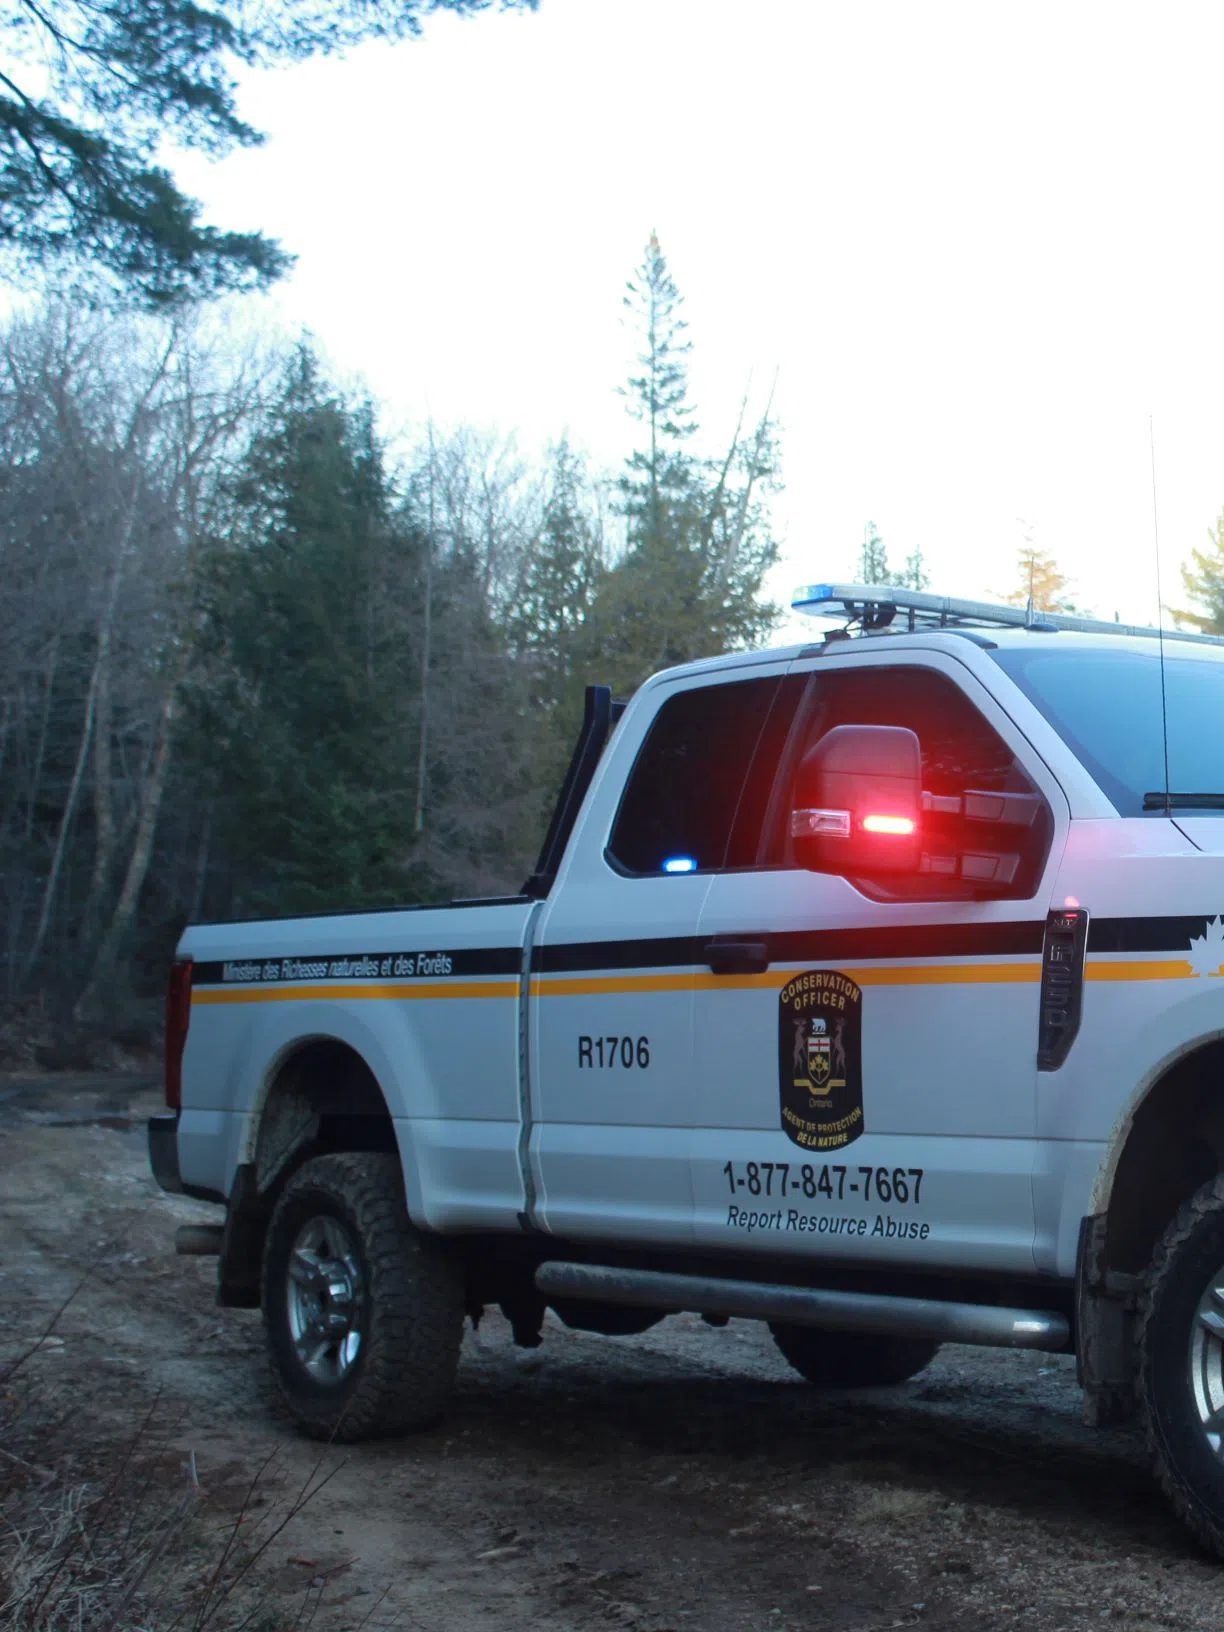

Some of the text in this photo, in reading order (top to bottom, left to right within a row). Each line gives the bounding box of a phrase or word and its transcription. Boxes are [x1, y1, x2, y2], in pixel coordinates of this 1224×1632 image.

[262, 961, 280, 980] des
[281, 959, 329, 979] Richesses
[329, 956, 379, 977] naturelles
[380, 957, 392, 976] et
[394, 955, 415, 976] des
[416, 953, 453, 975] Forêts
[780, 973, 860, 1004] CONSERVATION
[794, 991, 846, 1011] OFFICER
[578, 1036, 650, 1068] R1706
[782, 1107, 862, 1132] AGENT DE PROTECTION
[797, 1132, 848, 1147] DE LA NATURE
[724, 1161, 924, 1203] 1-877-847-7667
[727, 1206, 930, 1240] Report Resource Abuse
